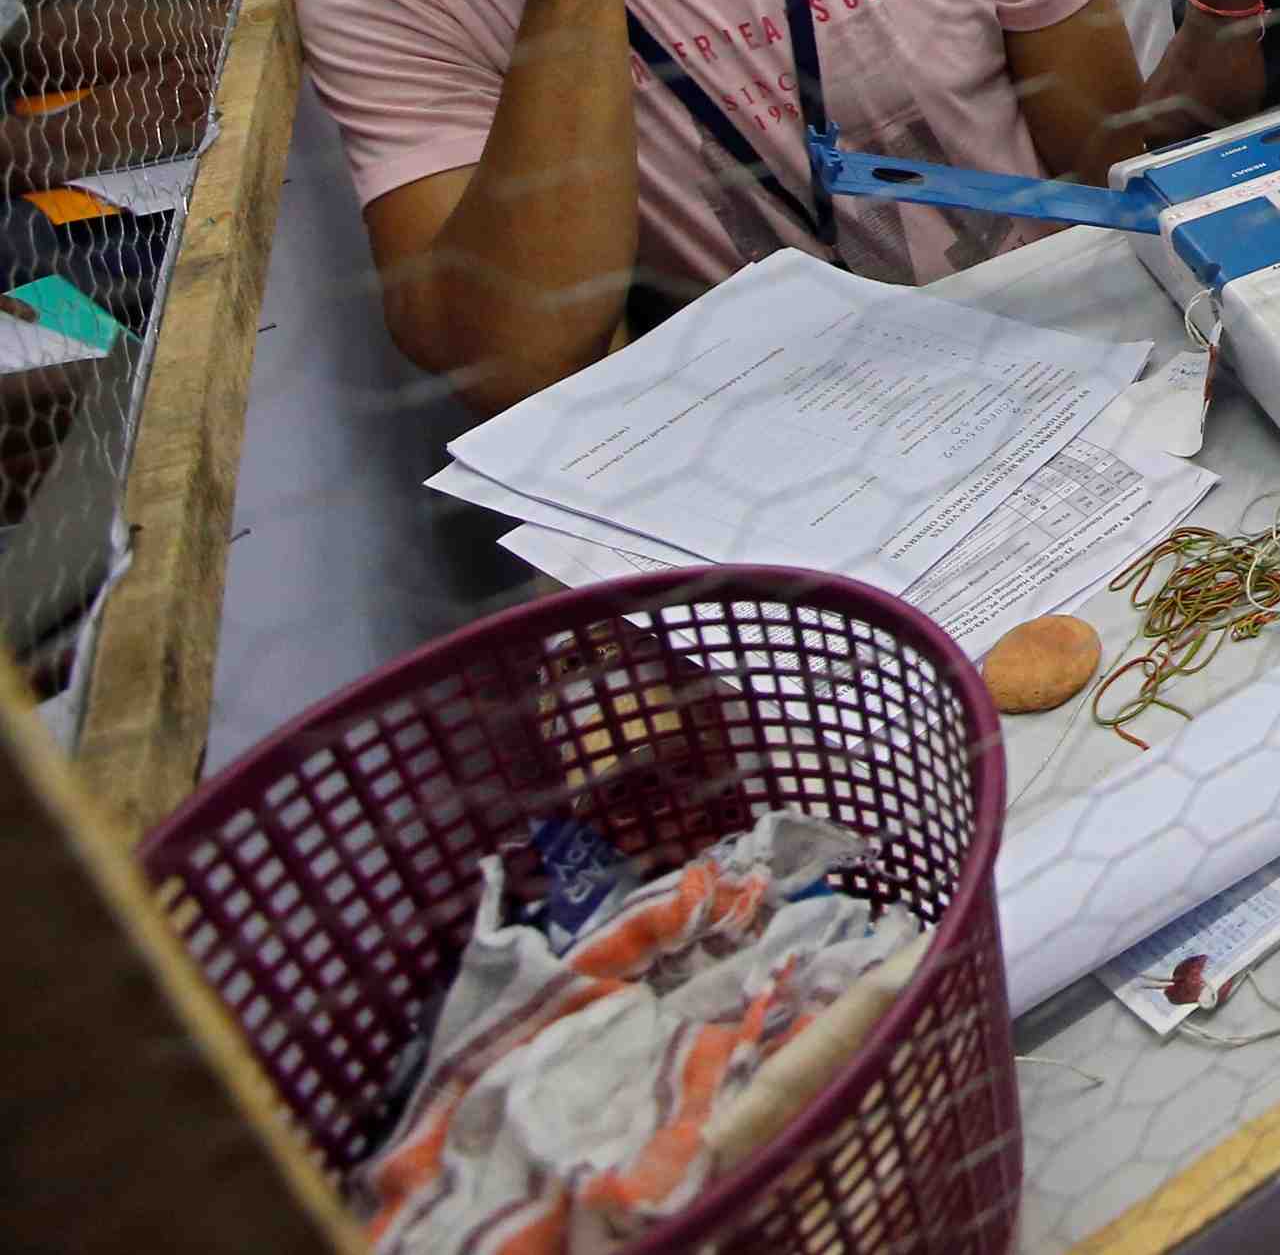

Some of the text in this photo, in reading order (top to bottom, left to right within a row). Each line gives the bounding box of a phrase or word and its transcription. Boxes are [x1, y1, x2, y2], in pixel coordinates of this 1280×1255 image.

[722, 71, 799, 112] SINC
[1029, 396, 1079, 440] ADDITIONAL
[928, 410, 1076, 540] PROFORMA FOR RECORDING OF VOTES
[989, 436, 1033, 474] COUNTING
[889, 518, 937, 561] OBSERVER
